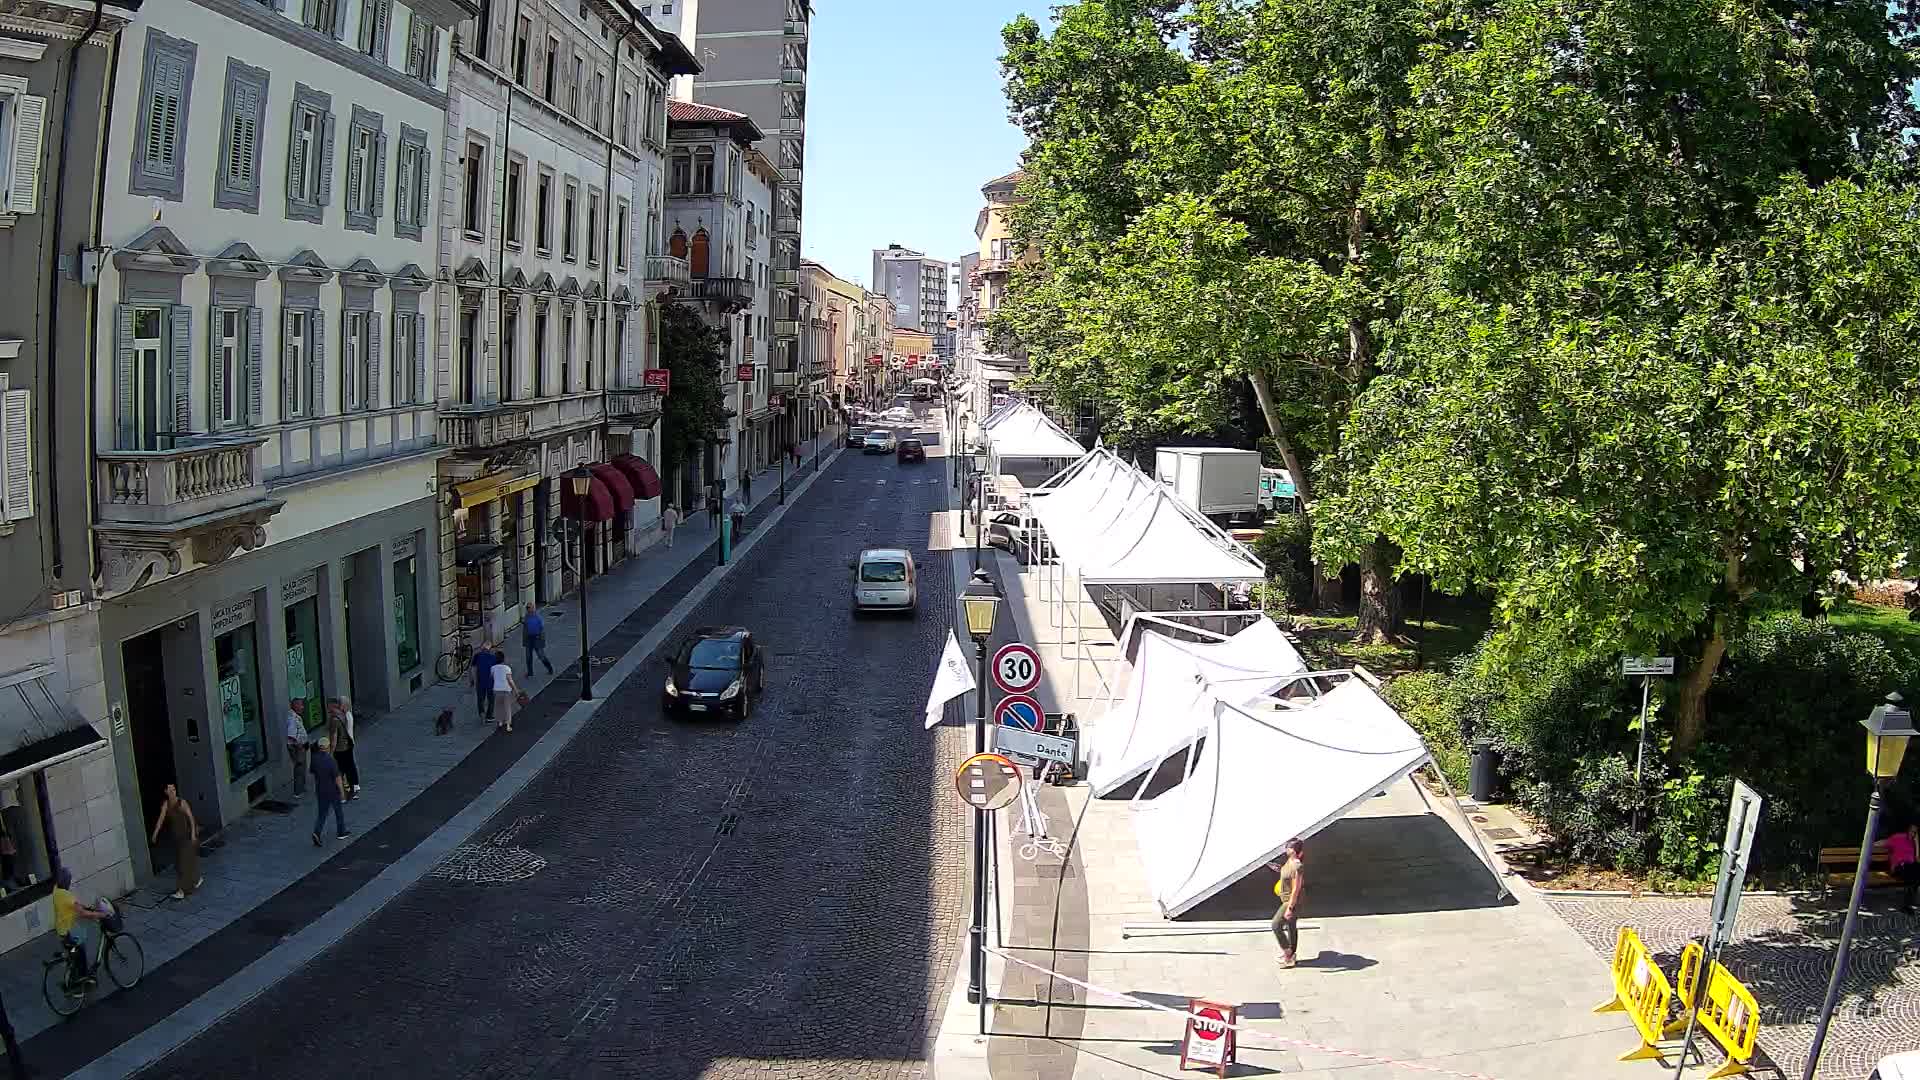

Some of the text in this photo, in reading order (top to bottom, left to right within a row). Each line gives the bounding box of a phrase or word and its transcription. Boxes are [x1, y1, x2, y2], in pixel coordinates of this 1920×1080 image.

[1004, 657, 1032, 680] 30
[1036, 744, 1067, 758] Dante
[1194, 1018, 1224, 1034] STOP
